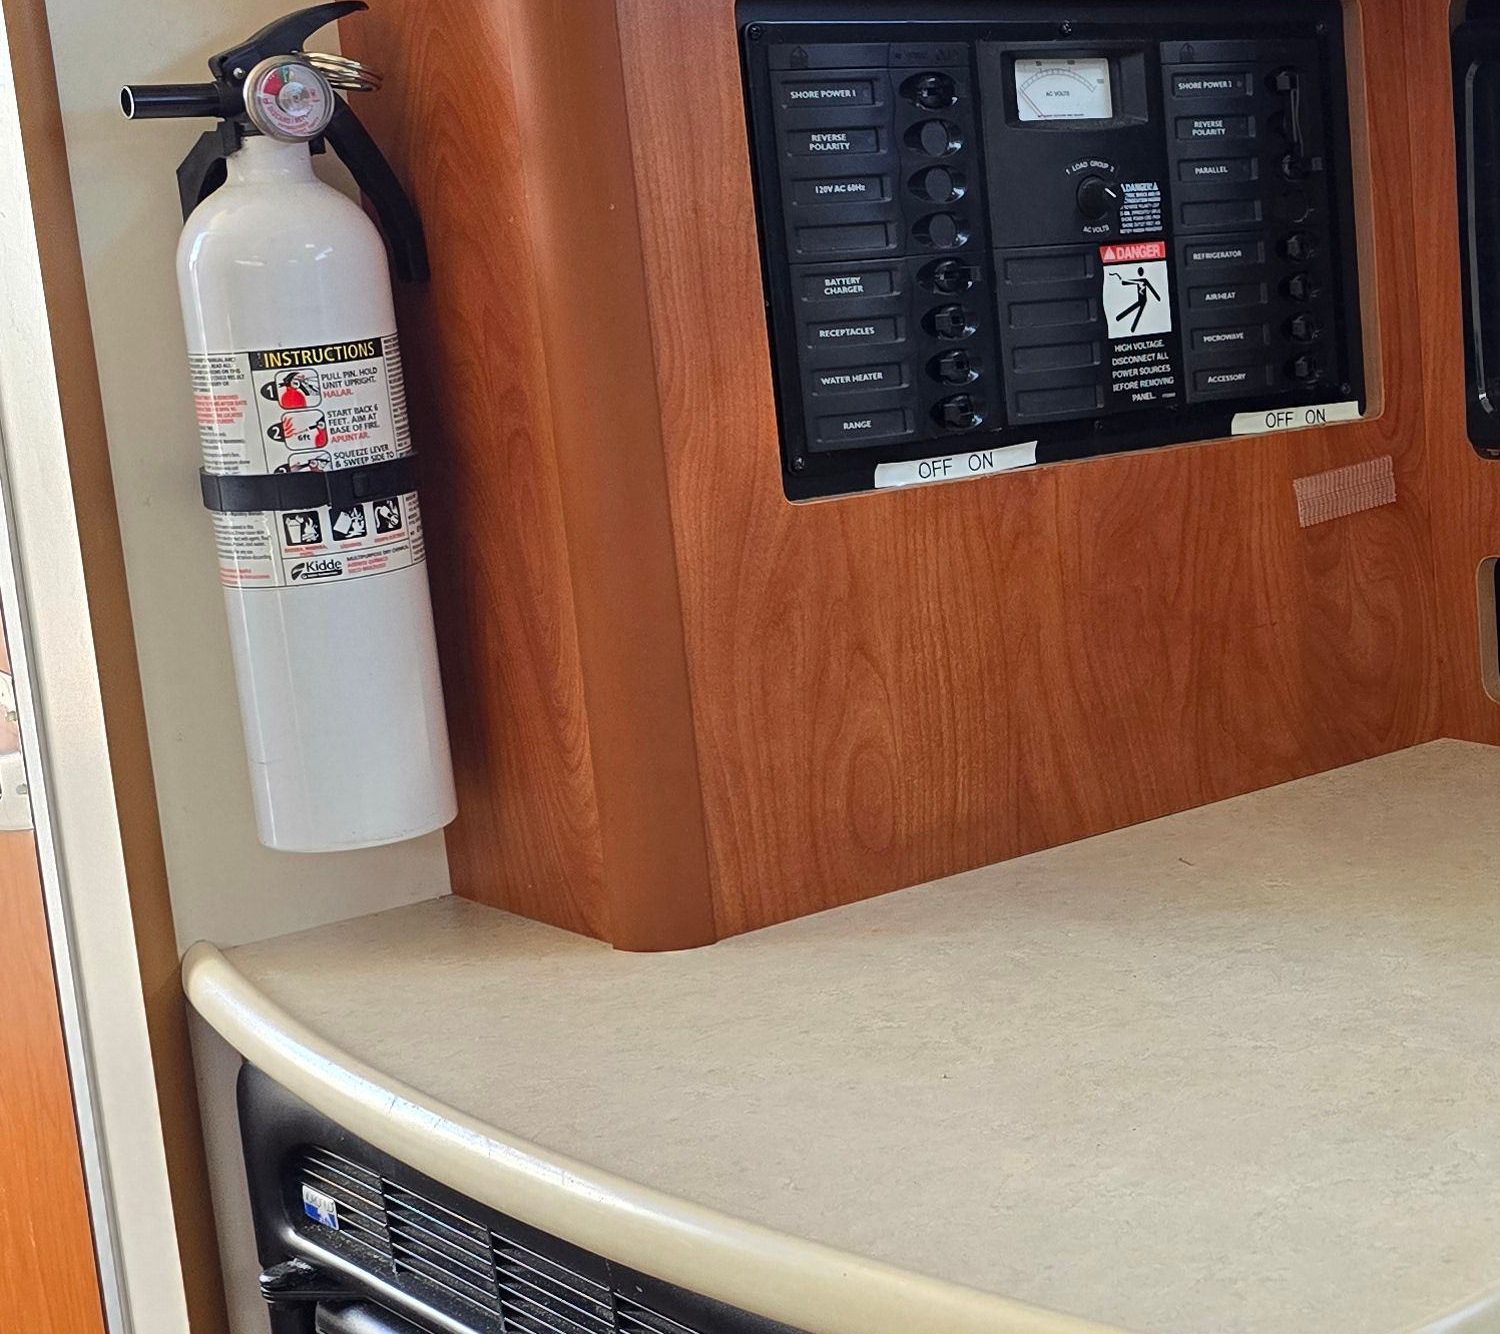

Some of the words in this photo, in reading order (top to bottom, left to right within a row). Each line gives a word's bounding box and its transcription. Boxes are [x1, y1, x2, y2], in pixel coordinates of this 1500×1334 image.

[1178, 82, 1202, 90] SHORE
[1203, 81, 1227, 89] POWER
[790, 91, 819, 99] SHORE
[821, 89, 851, 98] POWER
[1194, 120, 1223, 128] REVERSE
[811, 133, 847, 142] REVERSE
[1192, 128, 1226, 136] POLARITY
[809, 142, 850, 151] POLARITY
[1072, 161, 1088, 172] LOAD
[1090, 160, 1109, 169] GROUP
[1195, 166, 1228, 175] PARALLEL
[834, 184, 846, 193] AC
[1092, 224, 1110, 233] VOLTS
[1116, 244, 1160, 260] DANGER
[1193, 250, 1242, 260] REFRIGERATOR
[825, 277, 861, 286] BATTERY
[824, 285, 864, 295] CHARGER
[819, 327, 875, 338] RECEPTACLES
[1203, 332, 1244, 343] MICROWAVE
[1114, 343, 1132, 352] HIGH
[263, 341, 375, 368] INSTRUCTIONS
[1112, 353, 1156, 366] DISCONNECT
[1156, 352, 1168, 360] ALL
[321, 372, 341, 381] PULL
[343, 370, 358, 379] PIN.
[359, 367, 378, 376] HOLD
[1112, 368, 1138, 379] POWER
[1139, 364, 1171, 375] SOURCES
[820, 375, 851, 385] WATER
[852, 372, 883, 382] HEATER
[1207, 373, 1246, 383] ACCESSORY
[322, 381, 342, 390] UNIT
[1113, 381, 1139, 392] BEFORE
[1140, 376, 1174, 388] REMOVING
[267, 385, 274, 398] 1
[327, 408, 352, 418] START
[354, 405, 373, 415] BACK
[328, 417, 349, 426] FEET.
[352, 414, 367, 423] AIM
[368, 413, 377, 421] AT
[1265, 411, 1294, 428] OFF
[1305, 408, 1327, 424] ON
[330, 425, 351, 435] BASE
[843, 420, 872, 430] RANGE
[272, 427, 281, 440] 2
[297, 434, 311, 442] 6ft
[334, 447, 368, 460] SQUEEZE
[370, 444, 389, 453] LEVER
[344, 456, 370, 467] SWEEP
[371, 453, 386, 462] SIDE
[386, 451, 394, 459] TO
[919, 458, 952, 479] OFF
[968, 451, 994, 471] ON
[305, 559, 342, 572] Kidde
